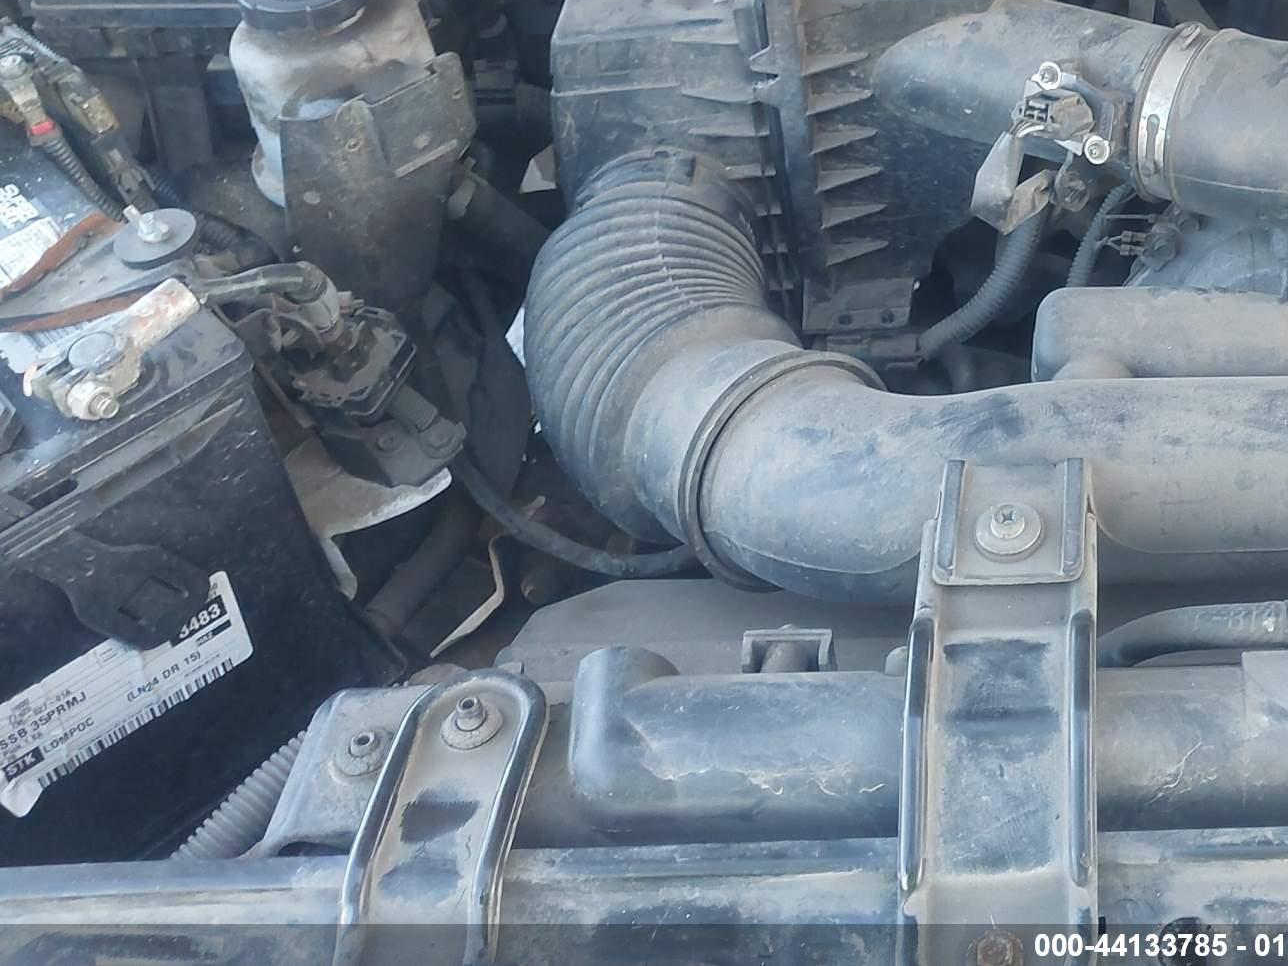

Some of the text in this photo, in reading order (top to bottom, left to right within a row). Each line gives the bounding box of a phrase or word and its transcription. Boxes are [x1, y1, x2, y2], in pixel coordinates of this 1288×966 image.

[43, 716, 95, 754] LOMPOC
[162, 663, 180, 680] DR
[184, 650, 202, 666] 15)
